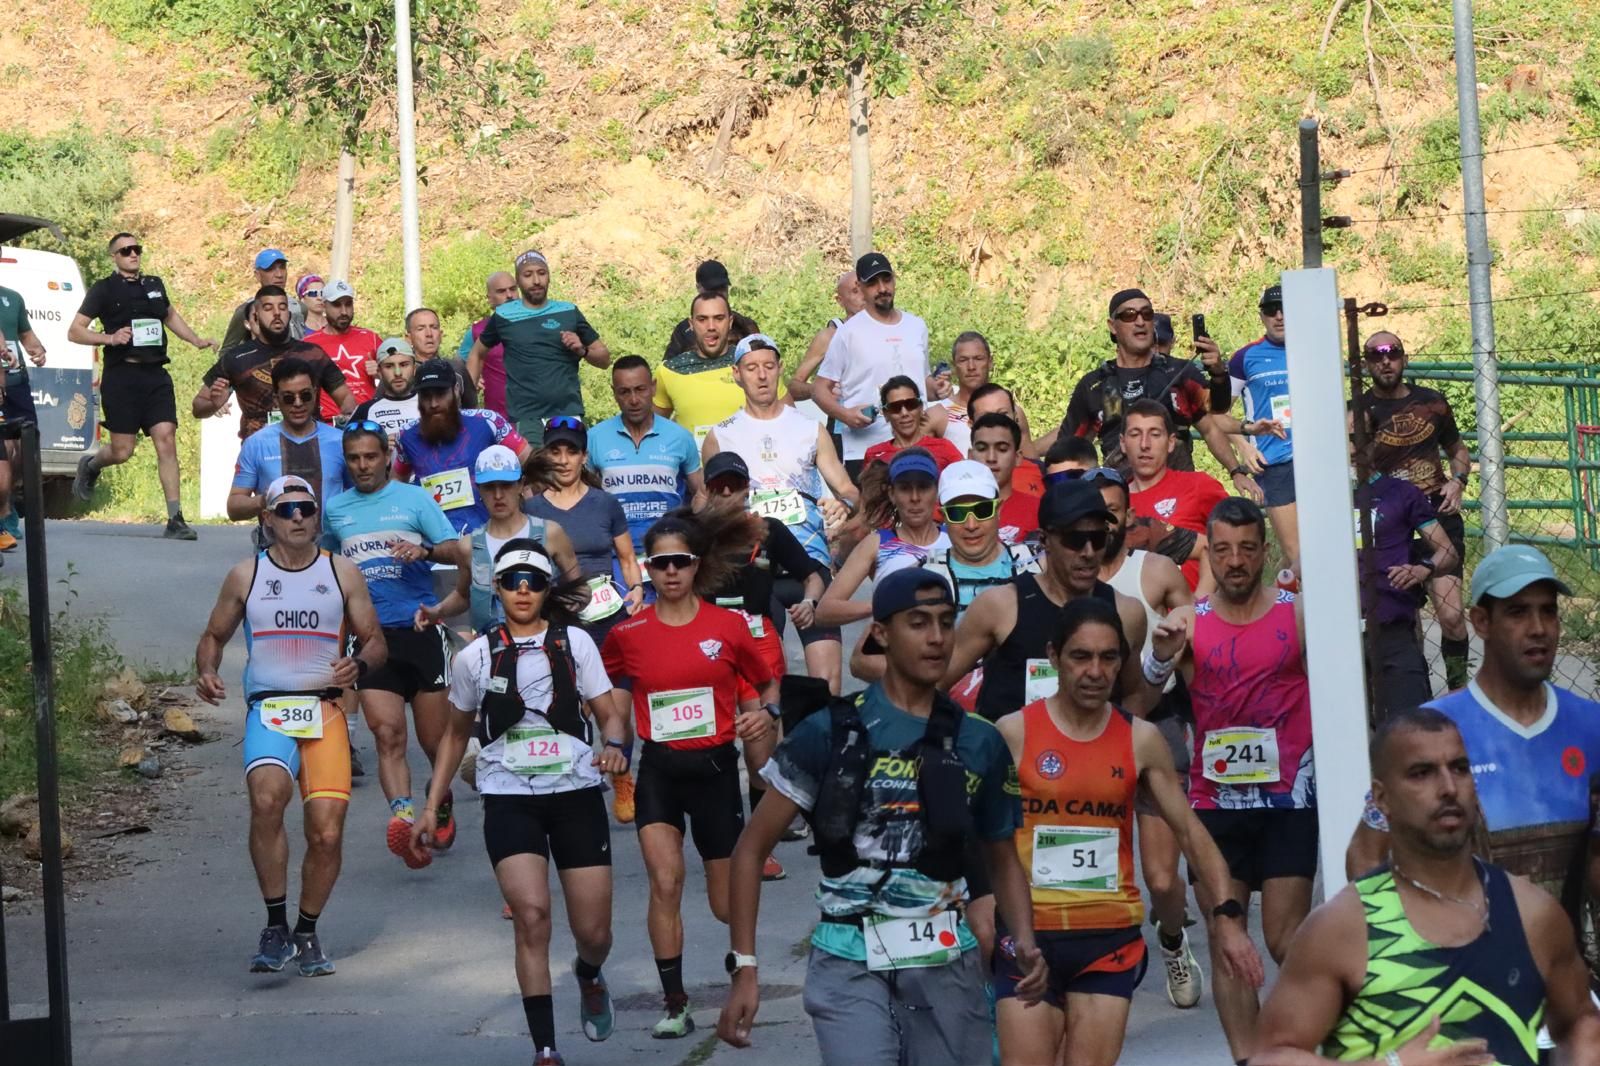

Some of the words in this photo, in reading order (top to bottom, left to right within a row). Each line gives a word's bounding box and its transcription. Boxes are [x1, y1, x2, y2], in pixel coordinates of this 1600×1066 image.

[146, 327, 160, 336] 142
[434, 480, 462, 497] 257
[604, 475, 625, 488] SAN
[627, 473, 674, 487] URBANO
[763, 495, 801, 515] 175-1
[592, 588, 612, 605] 103
[274, 610, 320, 630] CHICO
[280, 708, 313, 722] 380
[671, 704, 704, 722] 105
[527, 740, 561, 757] 124
[1224, 744, 1267, 764] 241
[1037, 835, 1057, 846] 21K
[1072, 848, 1099, 869] 51
[907, 921, 936, 943] 14
